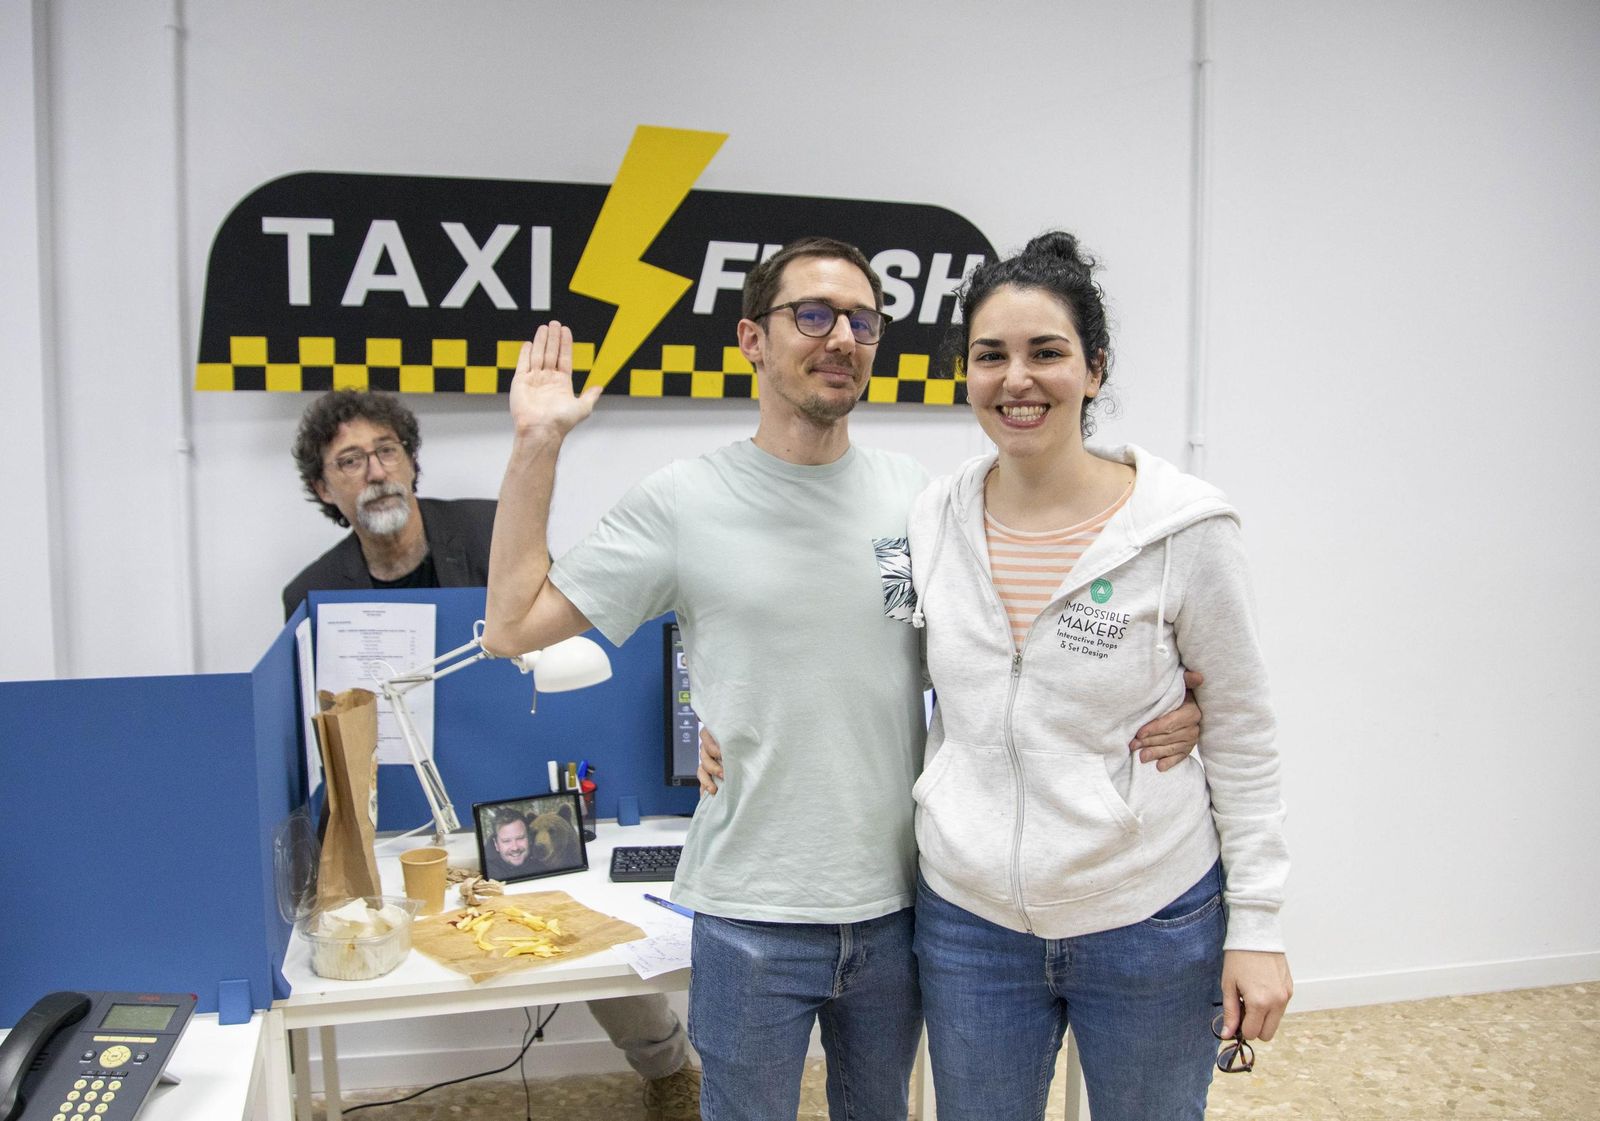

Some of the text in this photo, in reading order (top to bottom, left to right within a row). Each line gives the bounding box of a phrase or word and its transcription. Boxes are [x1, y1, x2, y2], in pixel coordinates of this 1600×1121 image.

[262, 216, 985, 325] TAXI FSH
[1064, 600, 1130, 625] IMPOSSIBLE
[1056, 628, 1118, 650] Interactive Props
[1057, 613, 1127, 640] MAKERS
[1060, 640, 1109, 659] & Set Design
